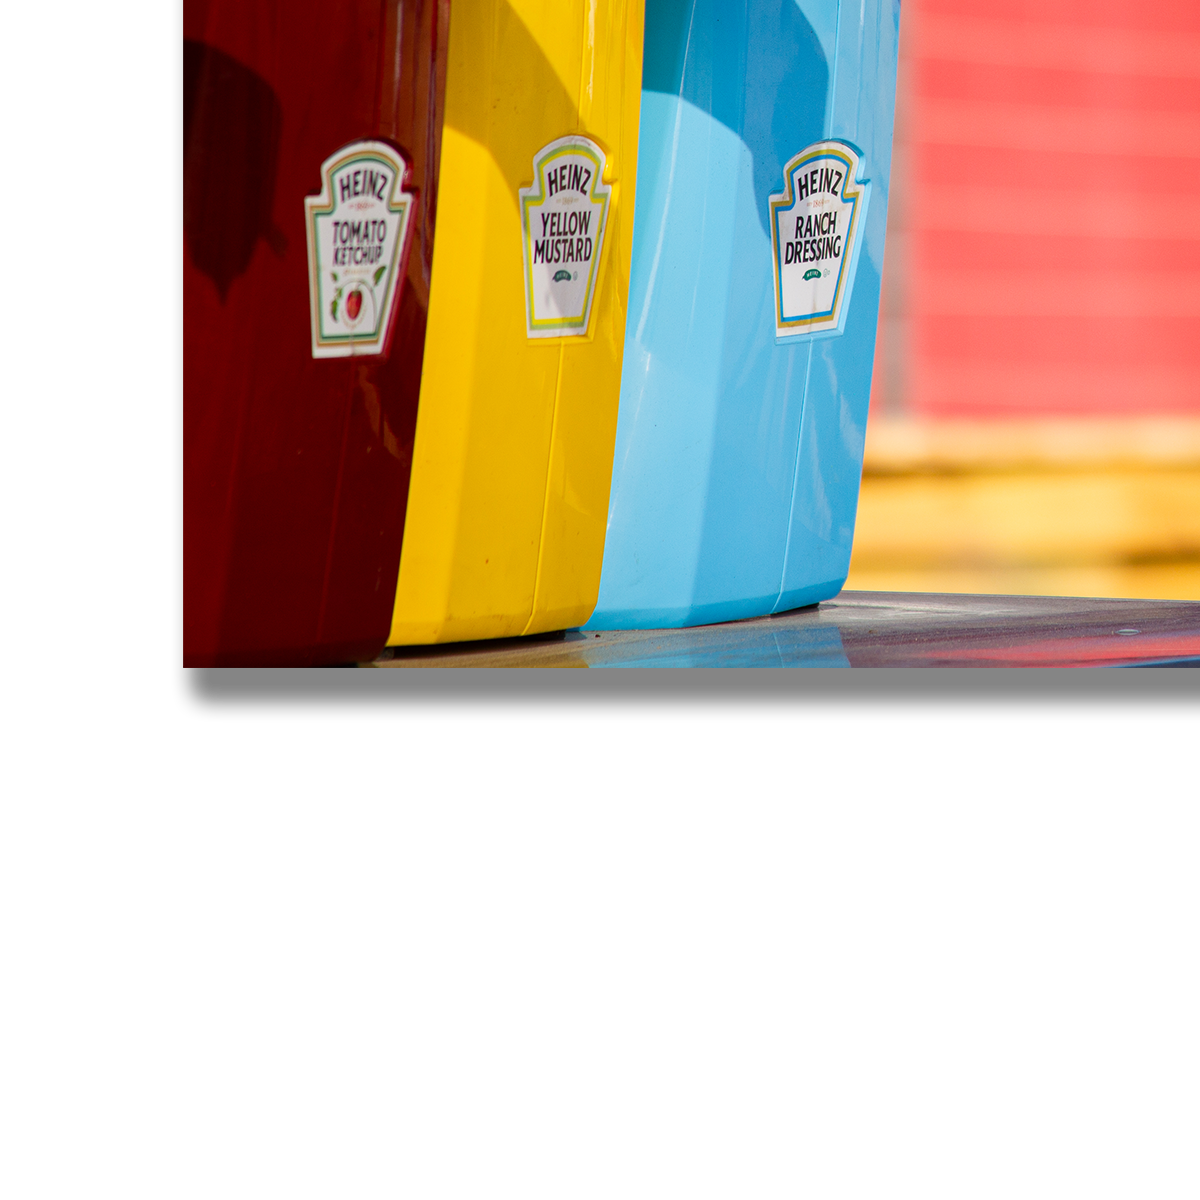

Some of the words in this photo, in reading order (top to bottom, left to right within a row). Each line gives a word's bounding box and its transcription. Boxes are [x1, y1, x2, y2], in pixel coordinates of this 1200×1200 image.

[340, 169, 387, 202] HEINZ
[547, 164, 591, 197] HEINZ
[797, 167, 842, 201] HEINZ
[333, 220, 386, 245] TOMATO
[541, 211, 591, 237] YELLOW
[795, 211, 837, 239] RANCH
[333, 246, 383, 266] KETCHUP
[534, 237, 592, 264] MUSTARD
[784, 235, 841, 265] DRESSING
